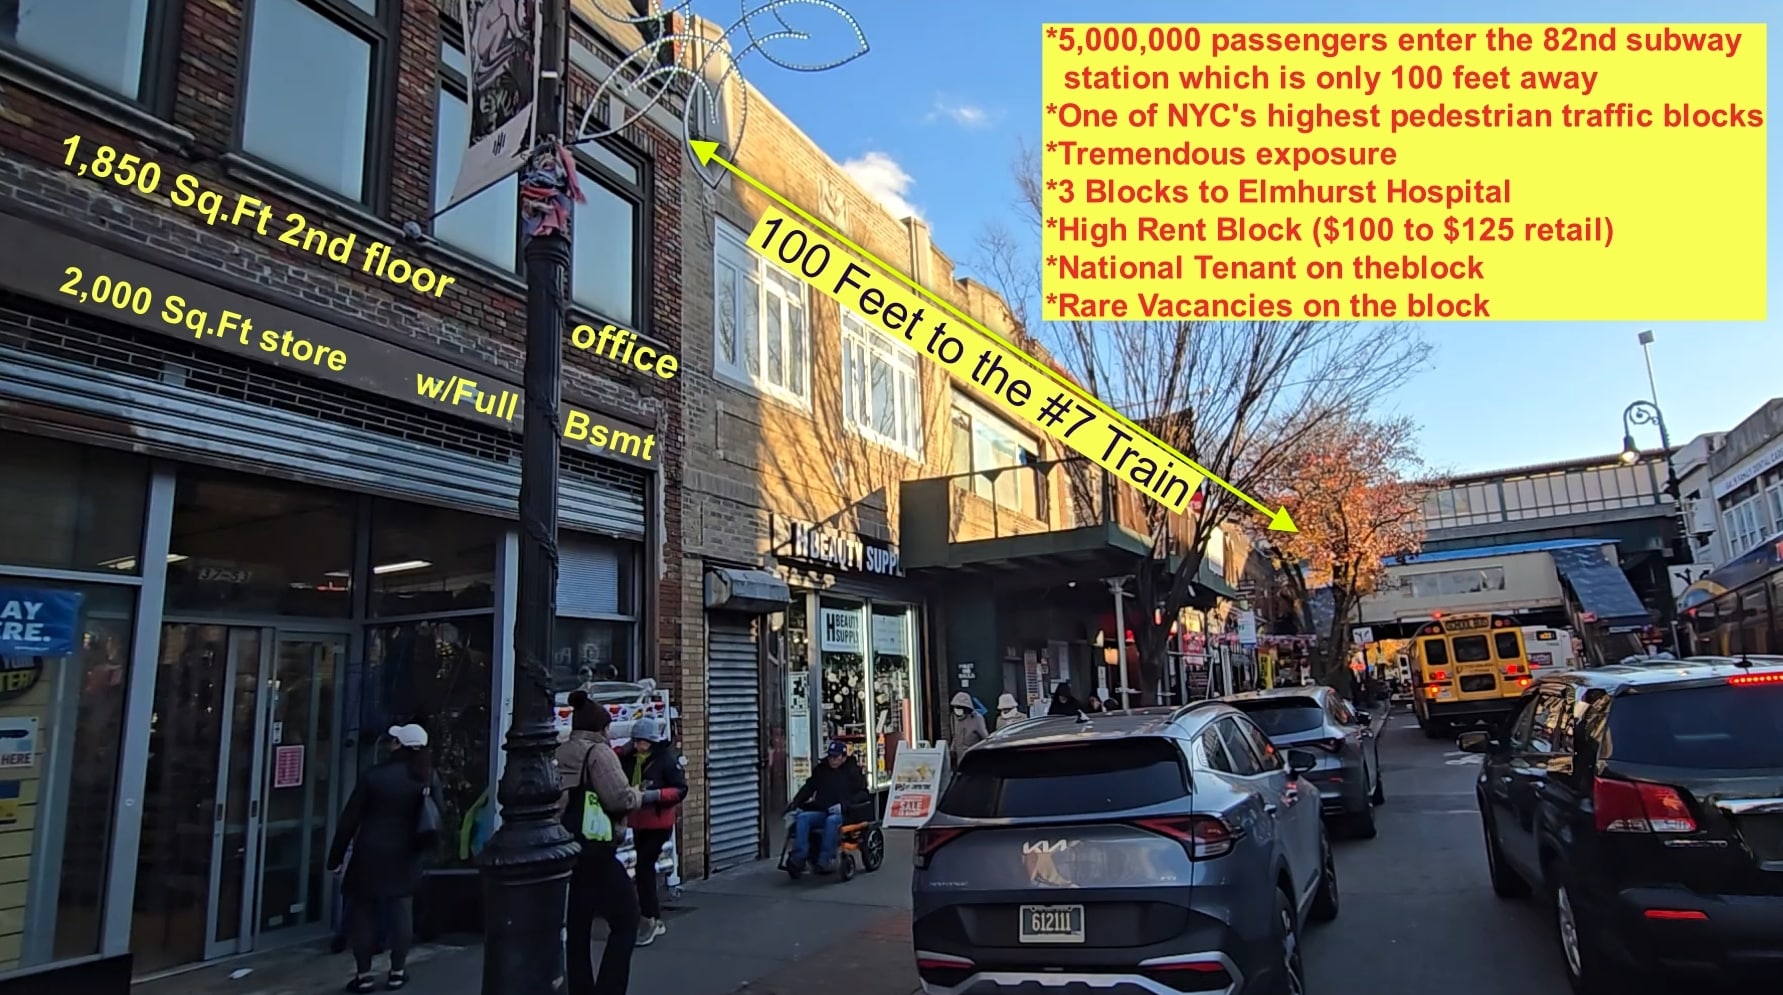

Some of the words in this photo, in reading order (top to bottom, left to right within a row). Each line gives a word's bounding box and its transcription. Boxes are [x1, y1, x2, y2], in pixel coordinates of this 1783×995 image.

[810, 534, 863, 571] BEAUTY
[866, 545, 904, 577] SUPPL
[1032, 912, 1072, 932] 612111
